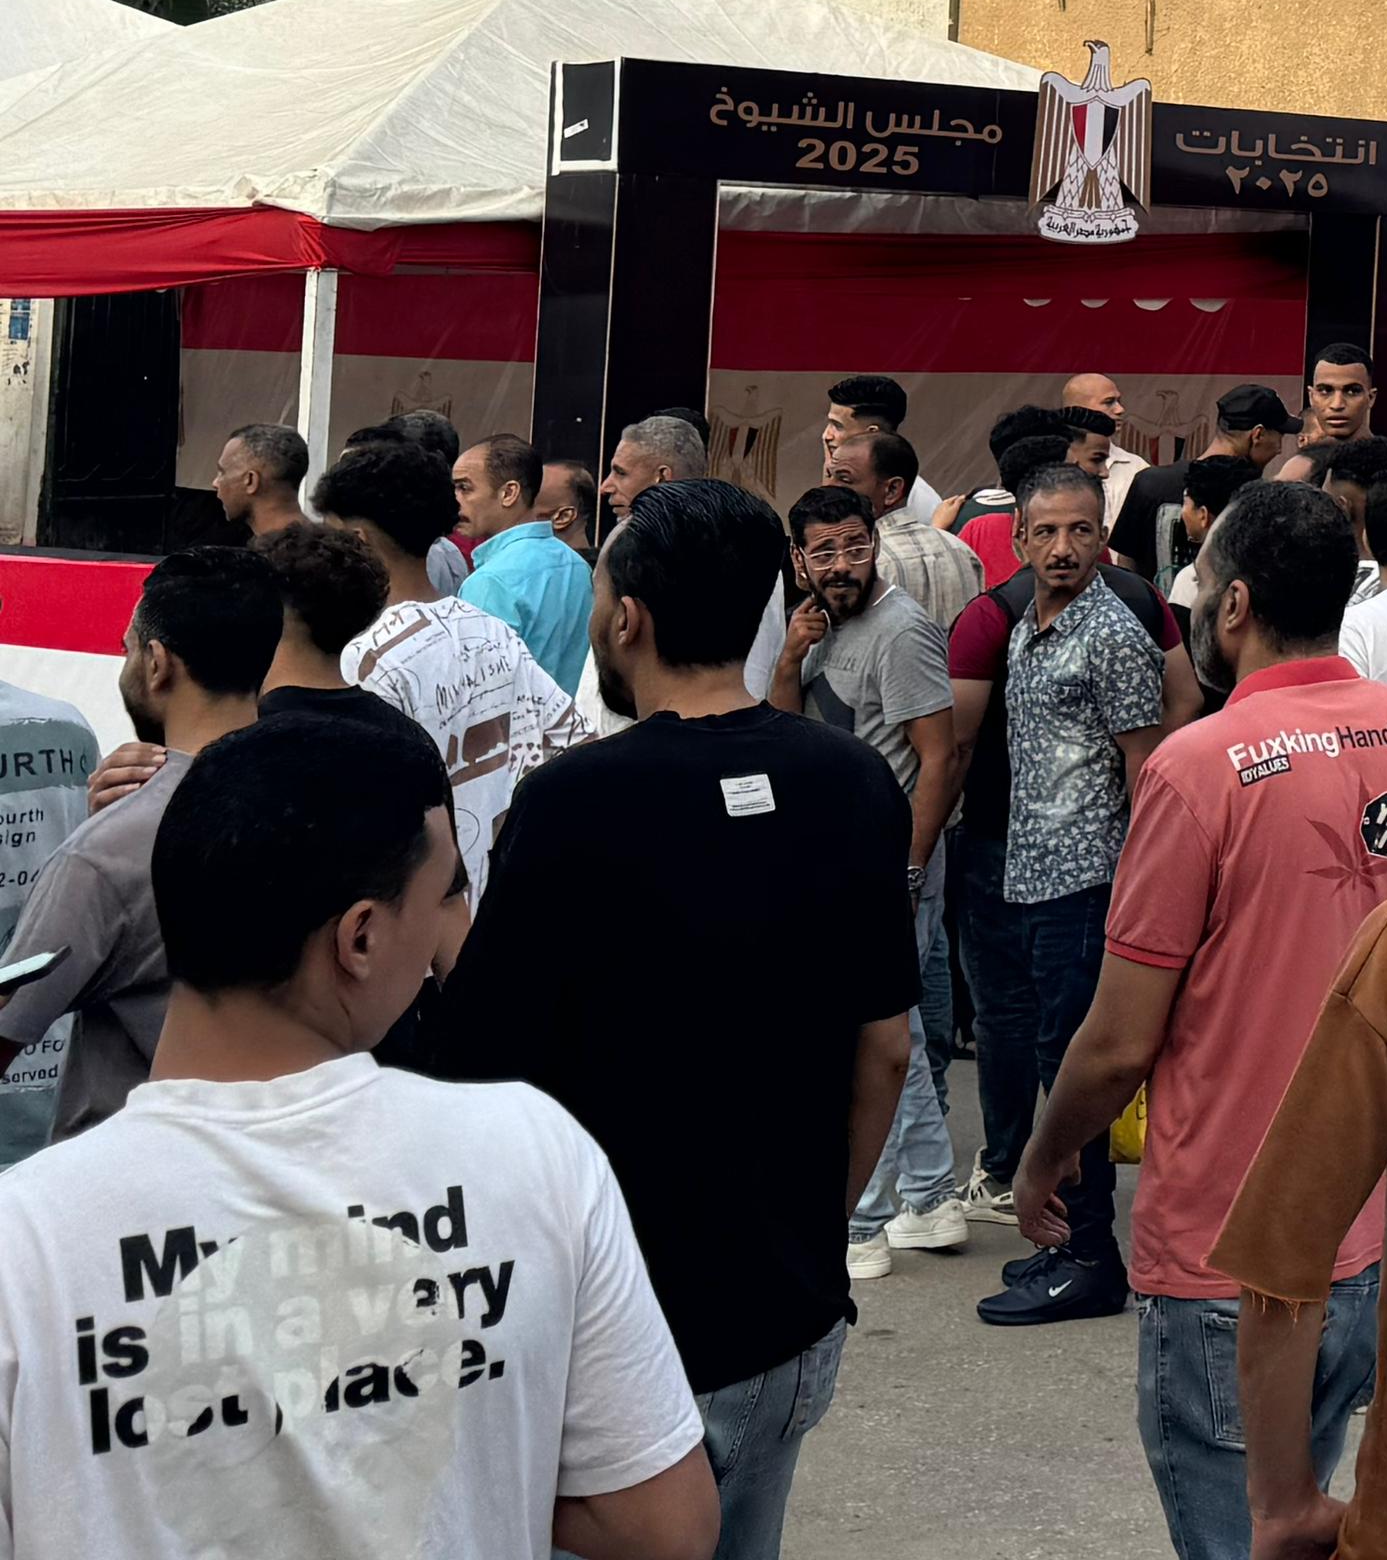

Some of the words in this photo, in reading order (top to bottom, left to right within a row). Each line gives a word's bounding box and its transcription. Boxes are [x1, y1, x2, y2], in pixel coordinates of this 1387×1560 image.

[709, 86, 855, 132] الشيوخ
[866, 108, 1003, 146] مجلس
[795, 138, 920, 175] 2025
[1176, 130, 1377, 166] انتخابات
[1225, 166, 1329, 198] ٢٠٢٥
[119, 1223, 247, 1303] My
[75, 1316, 149, 1386] is
